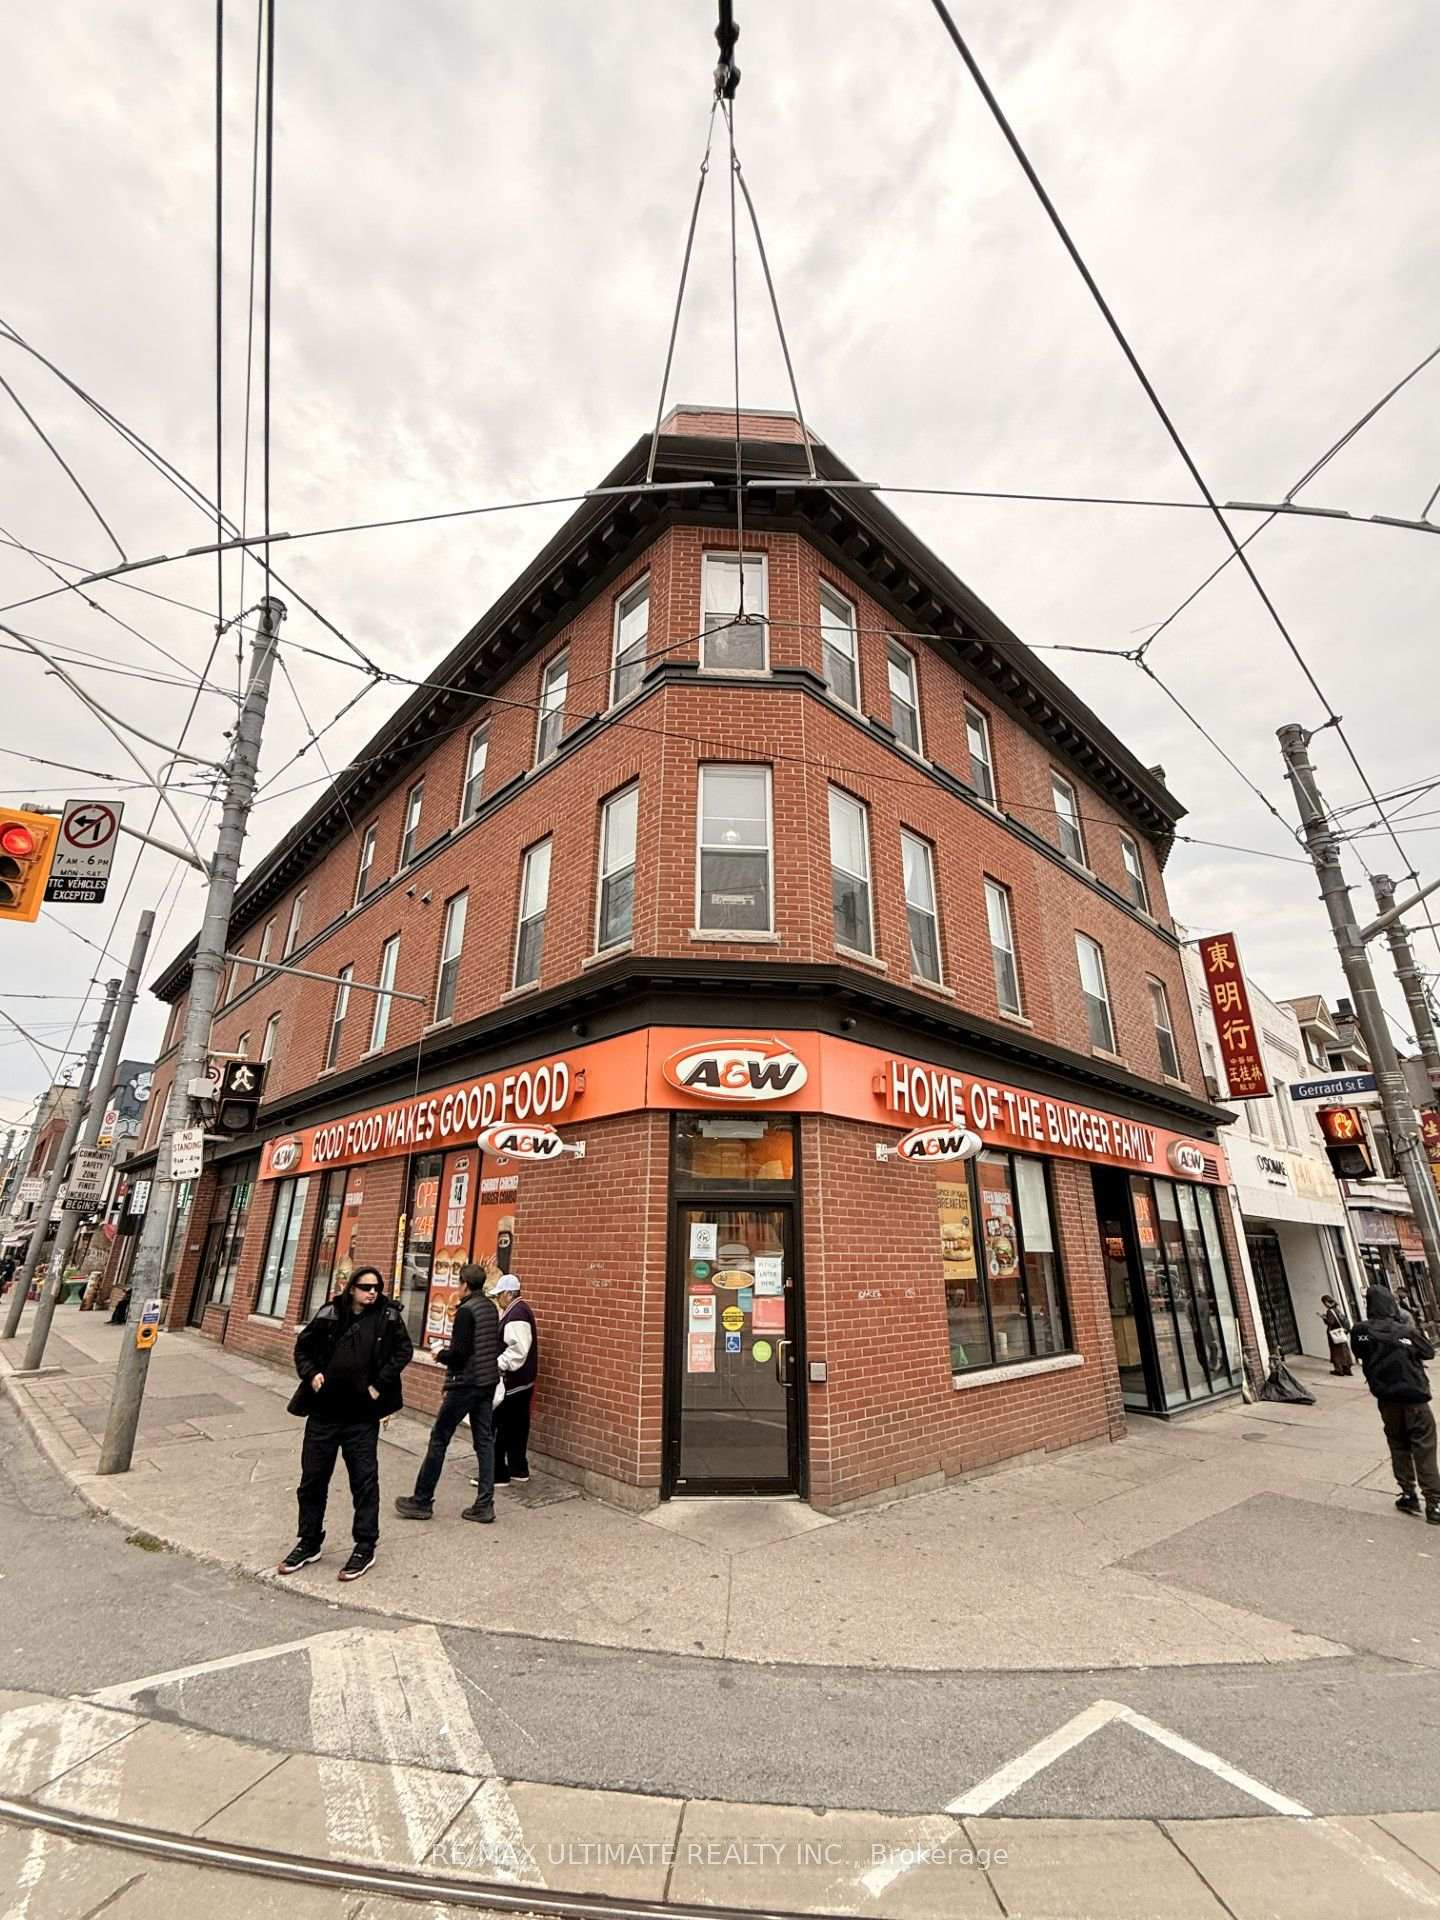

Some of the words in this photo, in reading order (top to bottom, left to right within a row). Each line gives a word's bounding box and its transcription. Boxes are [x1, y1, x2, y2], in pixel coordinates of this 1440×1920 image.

[56, 854, 65, 864] 7
[87, 855, 96, 865] 6
[48, 879, 65, 888] TTC
[67, 880, 107, 889] VEHICLES
[52, 890, 96, 900] EXCEPTED
[1207, 941, 1250, 1051] 東明行
[681, 1059, 799, 1090] A&W
[1229, 1063, 1263, 1082] 王桂林
[1298, 1080, 1343, 1097] Gerrard
[1345, 1080, 1356, 1091] St
[1356, 1078, 1366, 1089] E
[310, 1125, 345, 1163] GOOD
[345, 1114, 383, 1157] FOOD
[384, 1098, 438, 1149] MAKES
[439, 1082, 496, 1137] GOOD
[500, 1061, 569, 1122] FOOD
[891, 1060, 967, 1126] HOME
[970, 1083, 1000, 1131] OF
[1003, 1090, 1045, 1141] THE
[1045, 1102, 1113, 1155] BURGER
[1112, 1119, 1157, 1163] FAMILY
[183, 1132, 193, 1141] NO
[173, 1141, 202, 1153] STANDING
[500, 1135, 558, 1154] A&W
[908, 1134, 967, 1157] A&W
[79, 1149, 112, 1161] COMMUNITY
[1181, 1150, 1201, 1170] A&W
[81, 1160, 104, 1170] SAFETY
[82, 1170, 99, 1179] ZONE
[78, 1181, 97, 1191] FINES
[69, 1190, 101, 1200] INCREASED
[65, 1199, 98, 1211] BEGINS
